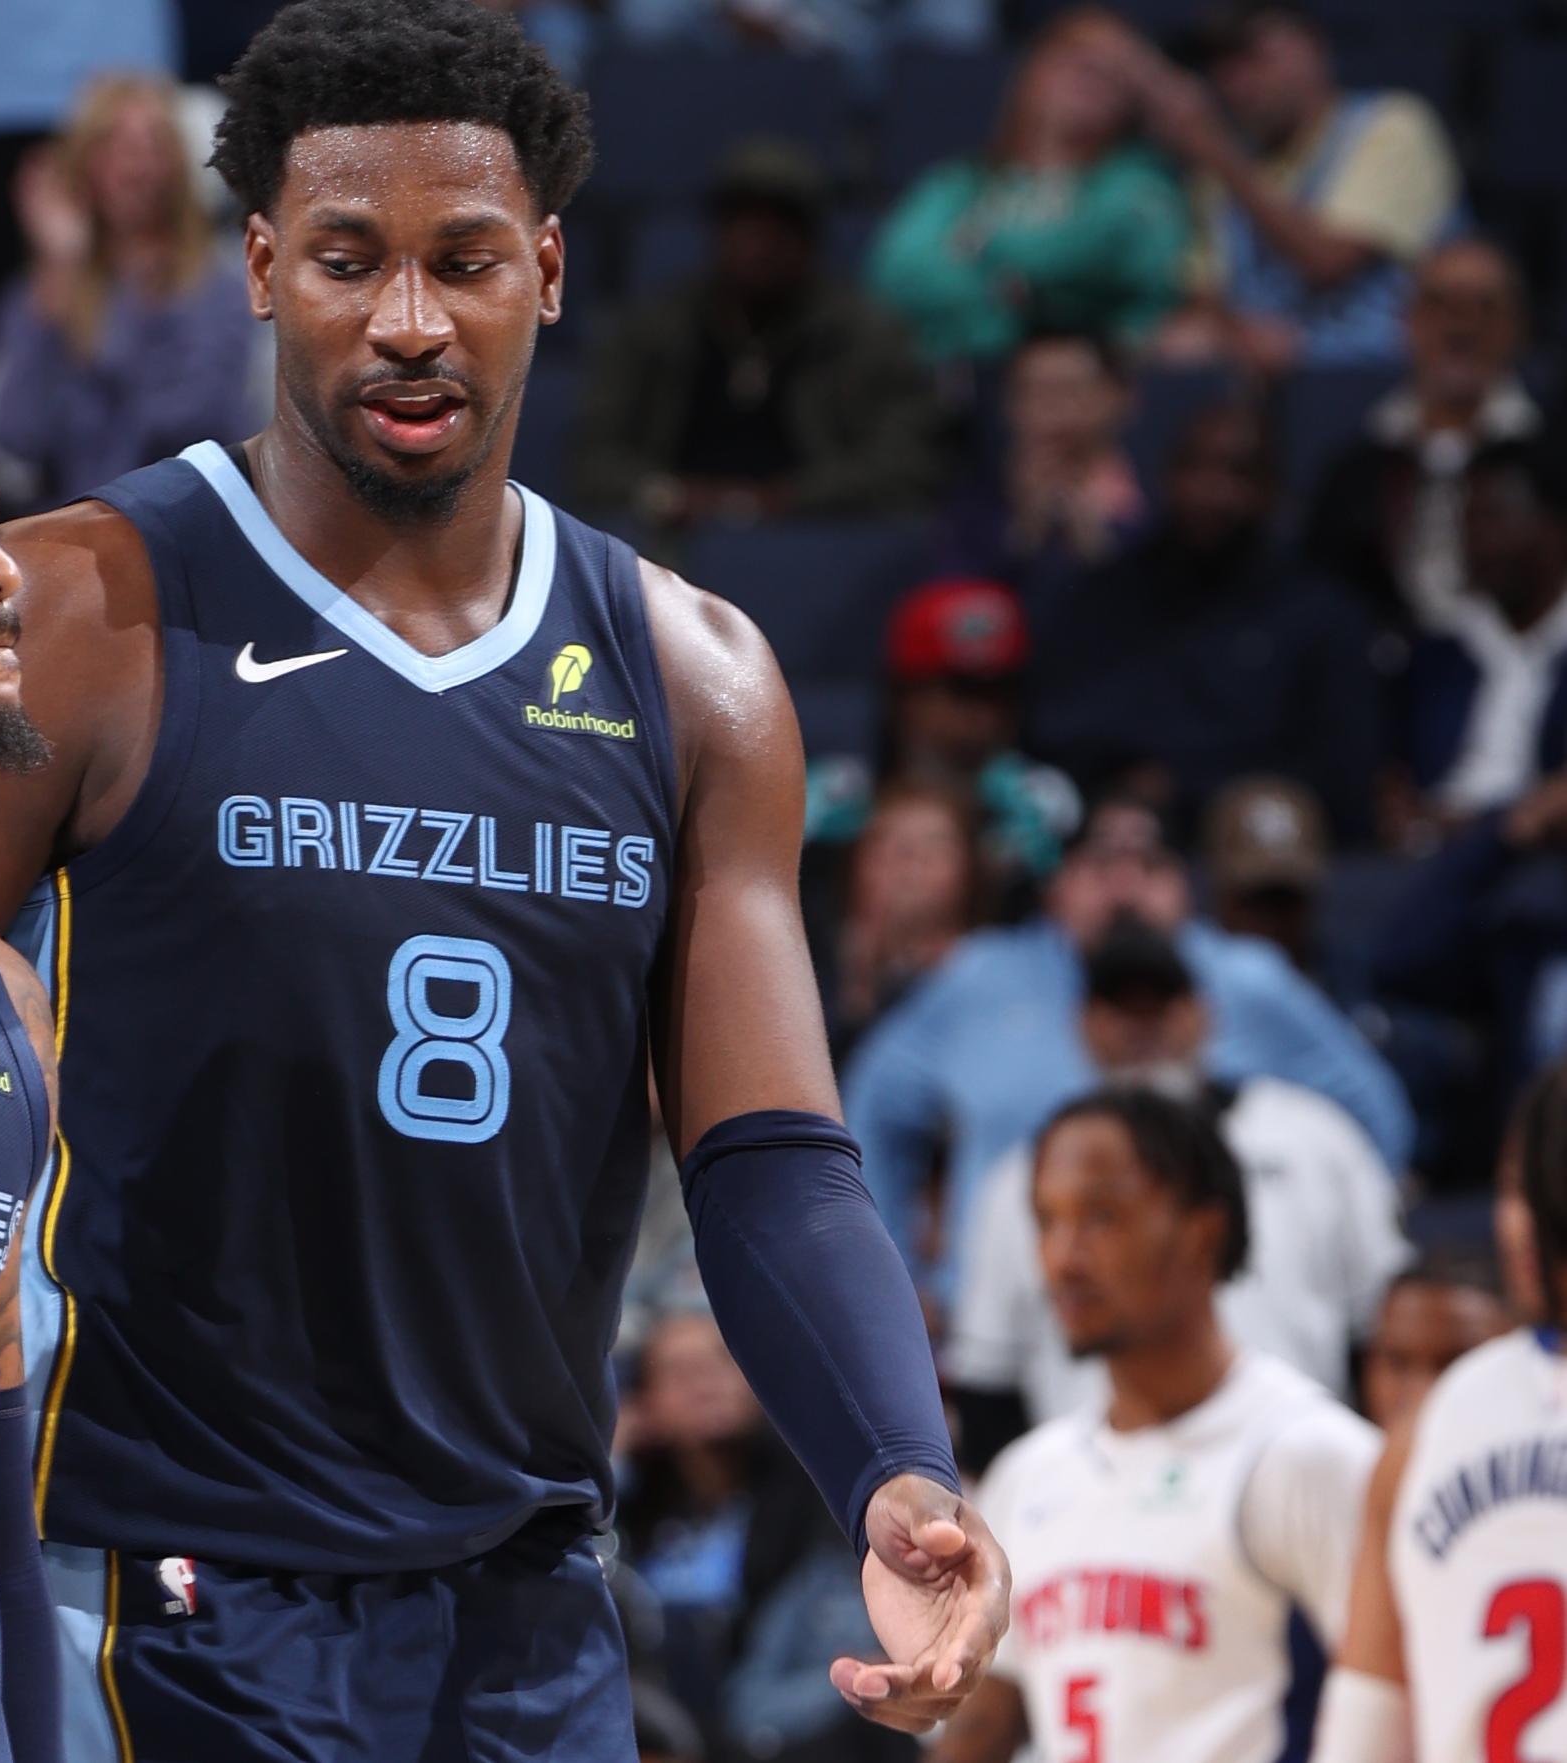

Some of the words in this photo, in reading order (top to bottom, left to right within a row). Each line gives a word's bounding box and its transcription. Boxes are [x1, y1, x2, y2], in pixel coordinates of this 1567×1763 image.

[525, 704, 635, 739] Robinhood
[217, 795, 655, 908] GRIZZLIES
[377, 934, 513, 1144] 8
[1063, 1673, 1103, 1763] 5
[1479, 1575, 1567, 1763] 2
